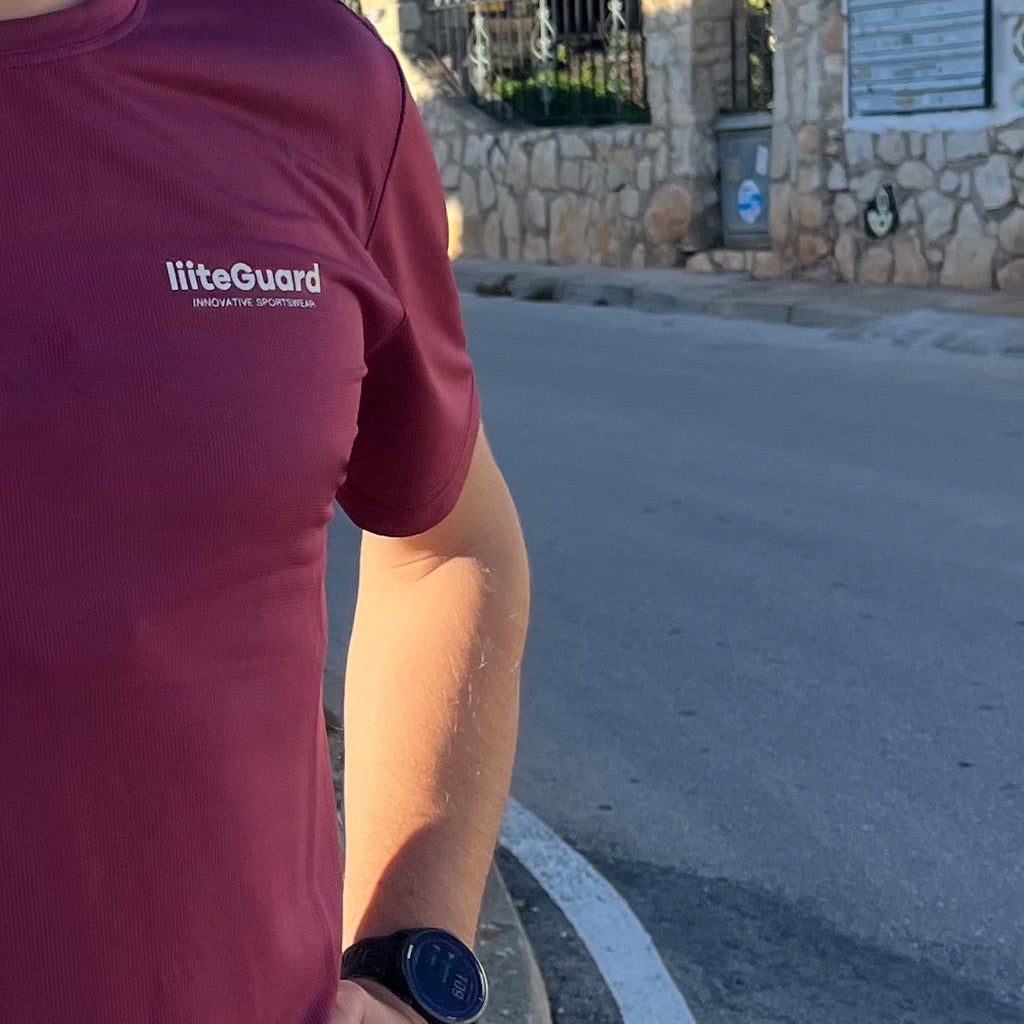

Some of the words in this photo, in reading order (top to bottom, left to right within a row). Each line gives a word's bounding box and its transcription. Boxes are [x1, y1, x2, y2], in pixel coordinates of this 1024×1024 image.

[165, 260, 321, 294] liiteGuard
[192, 297, 254, 308] INNOVATIVE
[256, 297, 317, 309] SPORTSWEAR
